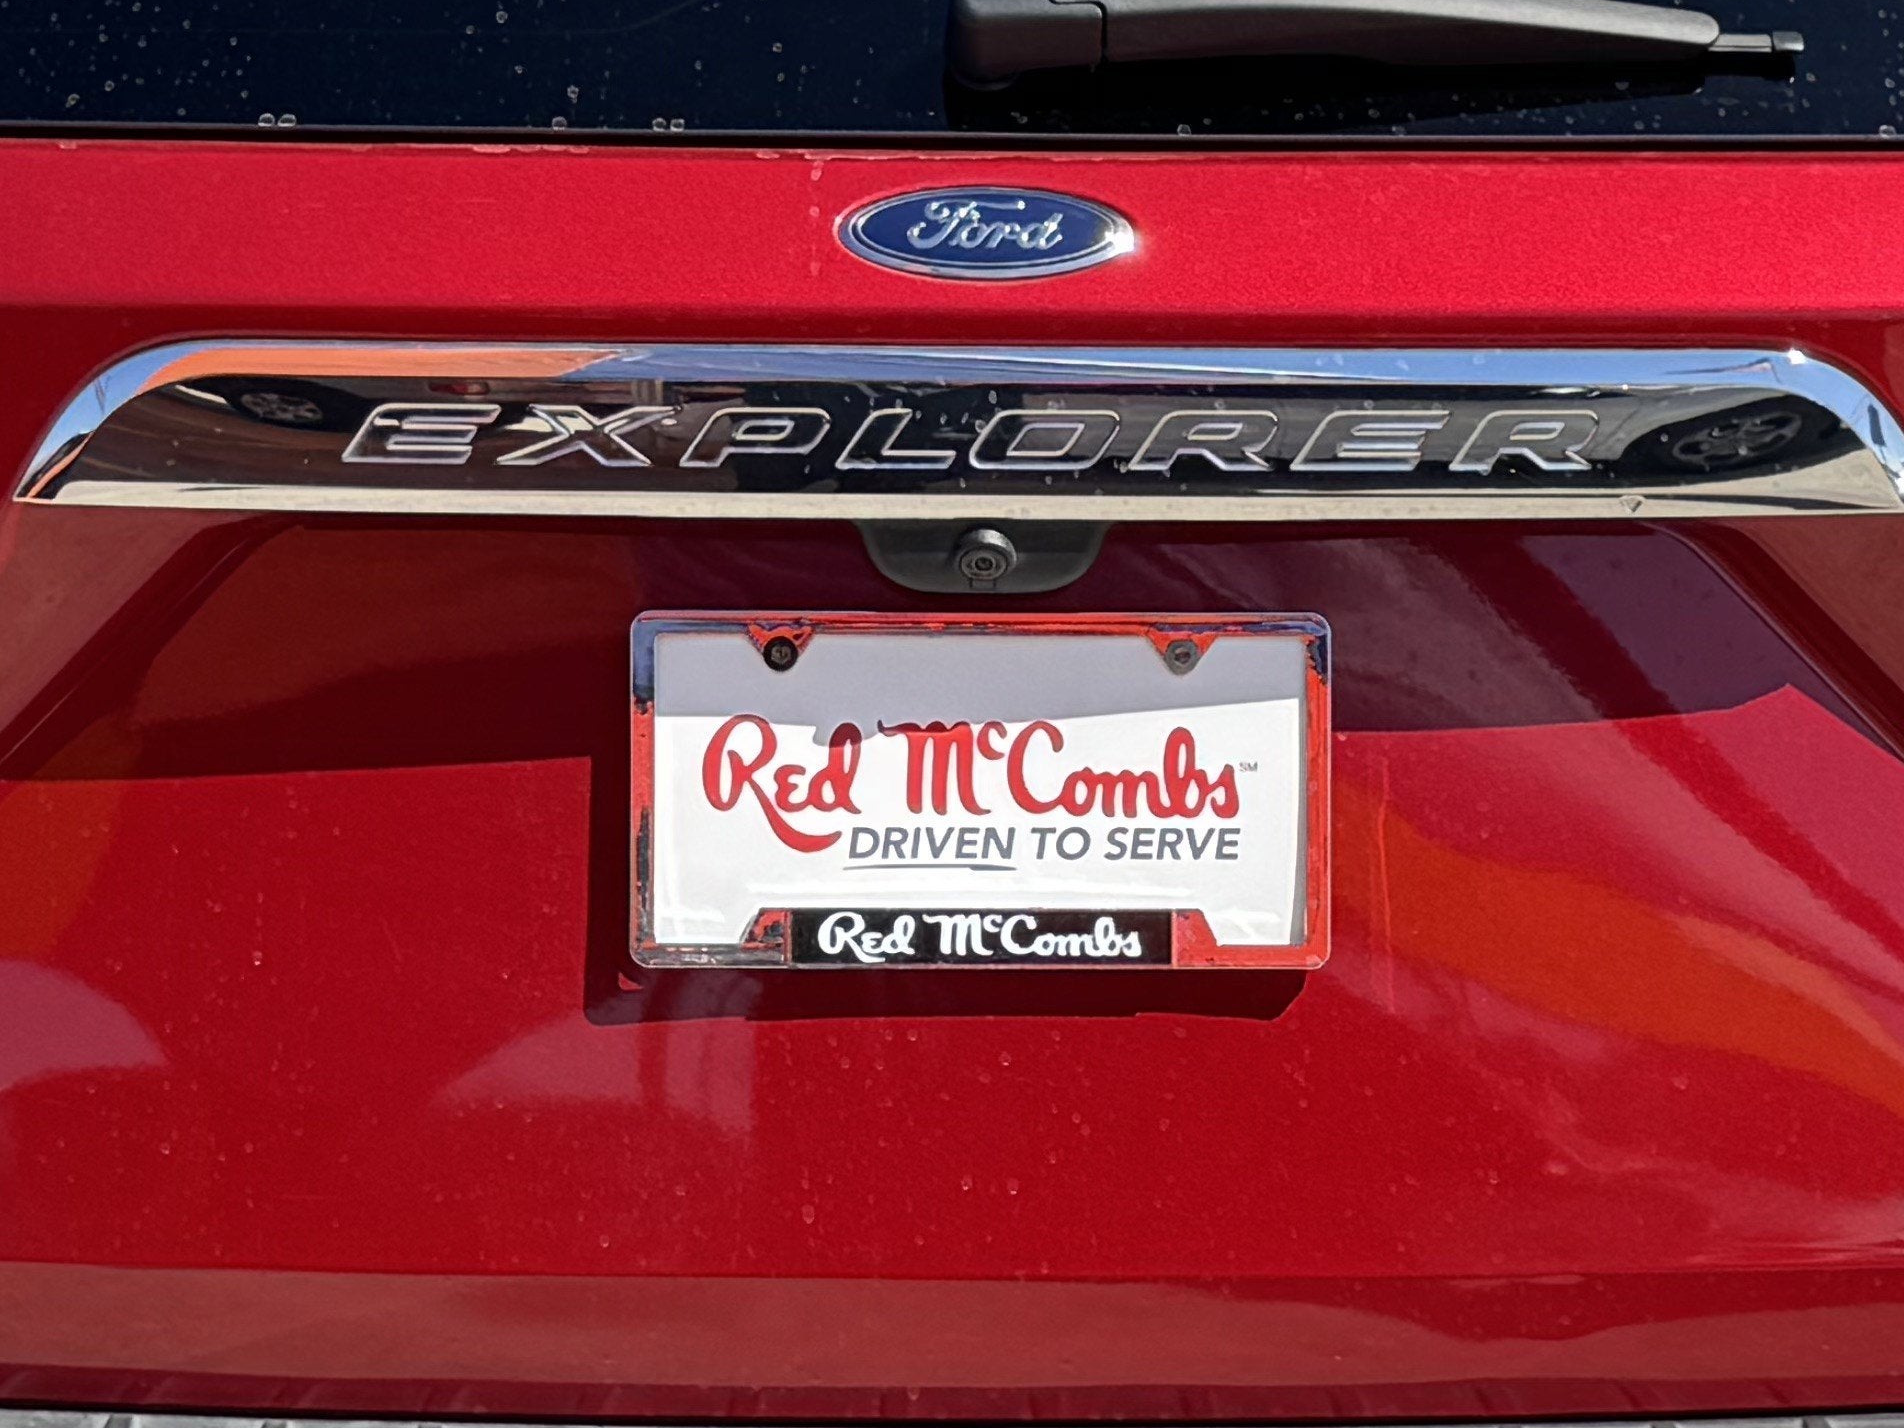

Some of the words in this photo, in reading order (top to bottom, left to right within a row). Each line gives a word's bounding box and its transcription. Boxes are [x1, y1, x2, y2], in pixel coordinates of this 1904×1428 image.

[906, 198, 1064, 250] Ford
[341, 402, 1599, 472] EXPLORER
[701, 712, 863, 853] Red
[876, 718, 1241, 819] McCombs
[847, 826, 1016, 860] DRIVEN
[1030, 825, 1091, 861] TO
[1104, 825, 1242, 861] SERVE
[817, 909, 916, 963] Red
[922, 911, 1143, 957] McCombs
